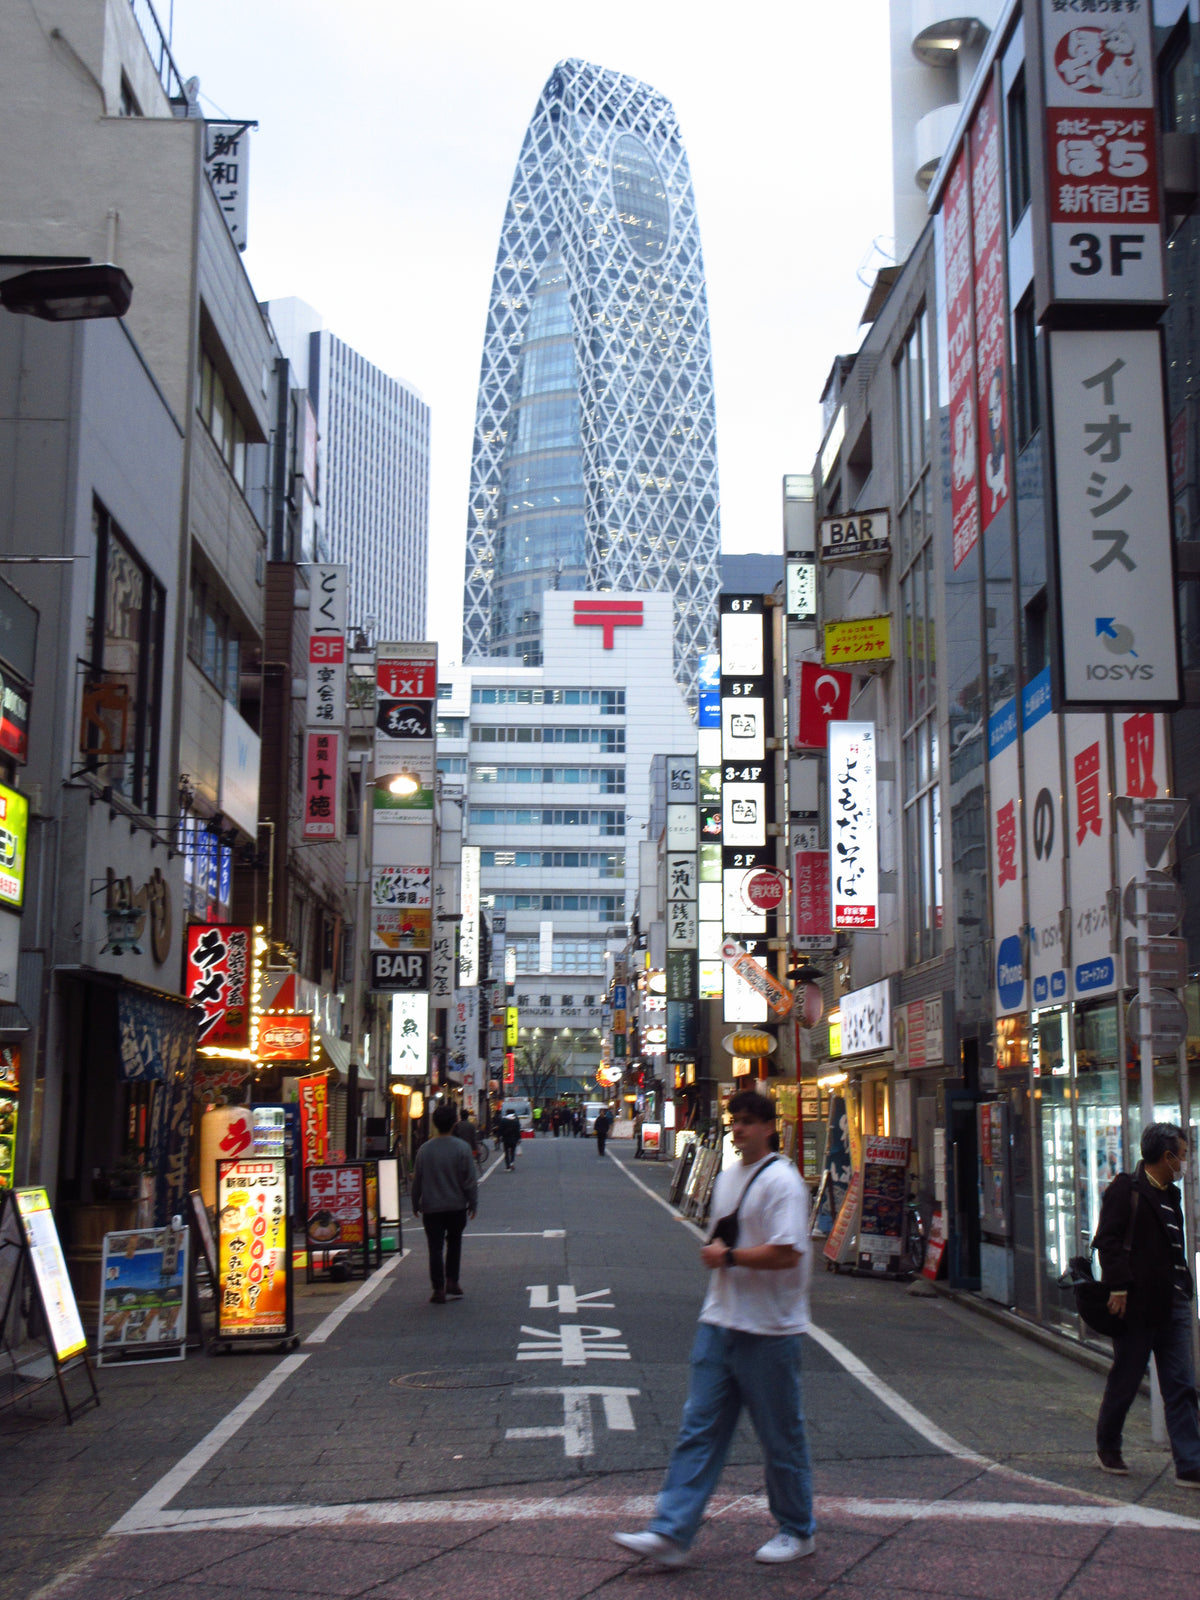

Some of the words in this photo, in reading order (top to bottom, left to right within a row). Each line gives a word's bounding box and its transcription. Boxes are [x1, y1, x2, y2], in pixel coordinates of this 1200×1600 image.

[1056, 118, 1147, 137] ホビーランド
[1056, 134, 1149, 178] ぽち
[212, 133, 238, 232] 新和ビ
[1058, 184, 1150, 214] 新宿店
[1069, 233, 1145, 276] 3F
[1082, 357, 1137, 574] イオシス
[830, 517, 874, 545] BAR
[796, 566, 808, 609] なごみ
[315, 571, 342, 633] とく一
[731, 600, 753, 611] 6F
[313, 642, 341, 658] 3F
[831, 640, 886, 657] チャンカヤ
[1087, 664, 1153, 681] IOSYS
[316, 667, 336, 721] 宴会場
[390, 674, 424, 695] ixi
[732, 683, 754, 695] 5F
[671, 769, 691, 781] KC
[308, 768, 332, 818] 十徳
[734, 854, 756, 866] 2F
[418, 896, 430, 904] 2F
[750, 884, 782, 899] 消火栓
[226, 931, 248, 1006] 横浜家系
[376, 955, 423, 977] BAR
[190, 928, 228, 1042] ラーメン
[560, 1008, 581, 1016] POST
[400, 1017, 420, 1060] 魚八
[226, 1176, 279, 1188] 新宿レモン
[311, 1170, 361, 1194] 学生
[310, 1195, 362, 1208] ラーメン
[504, 1284, 642, 1457] 止まれ
